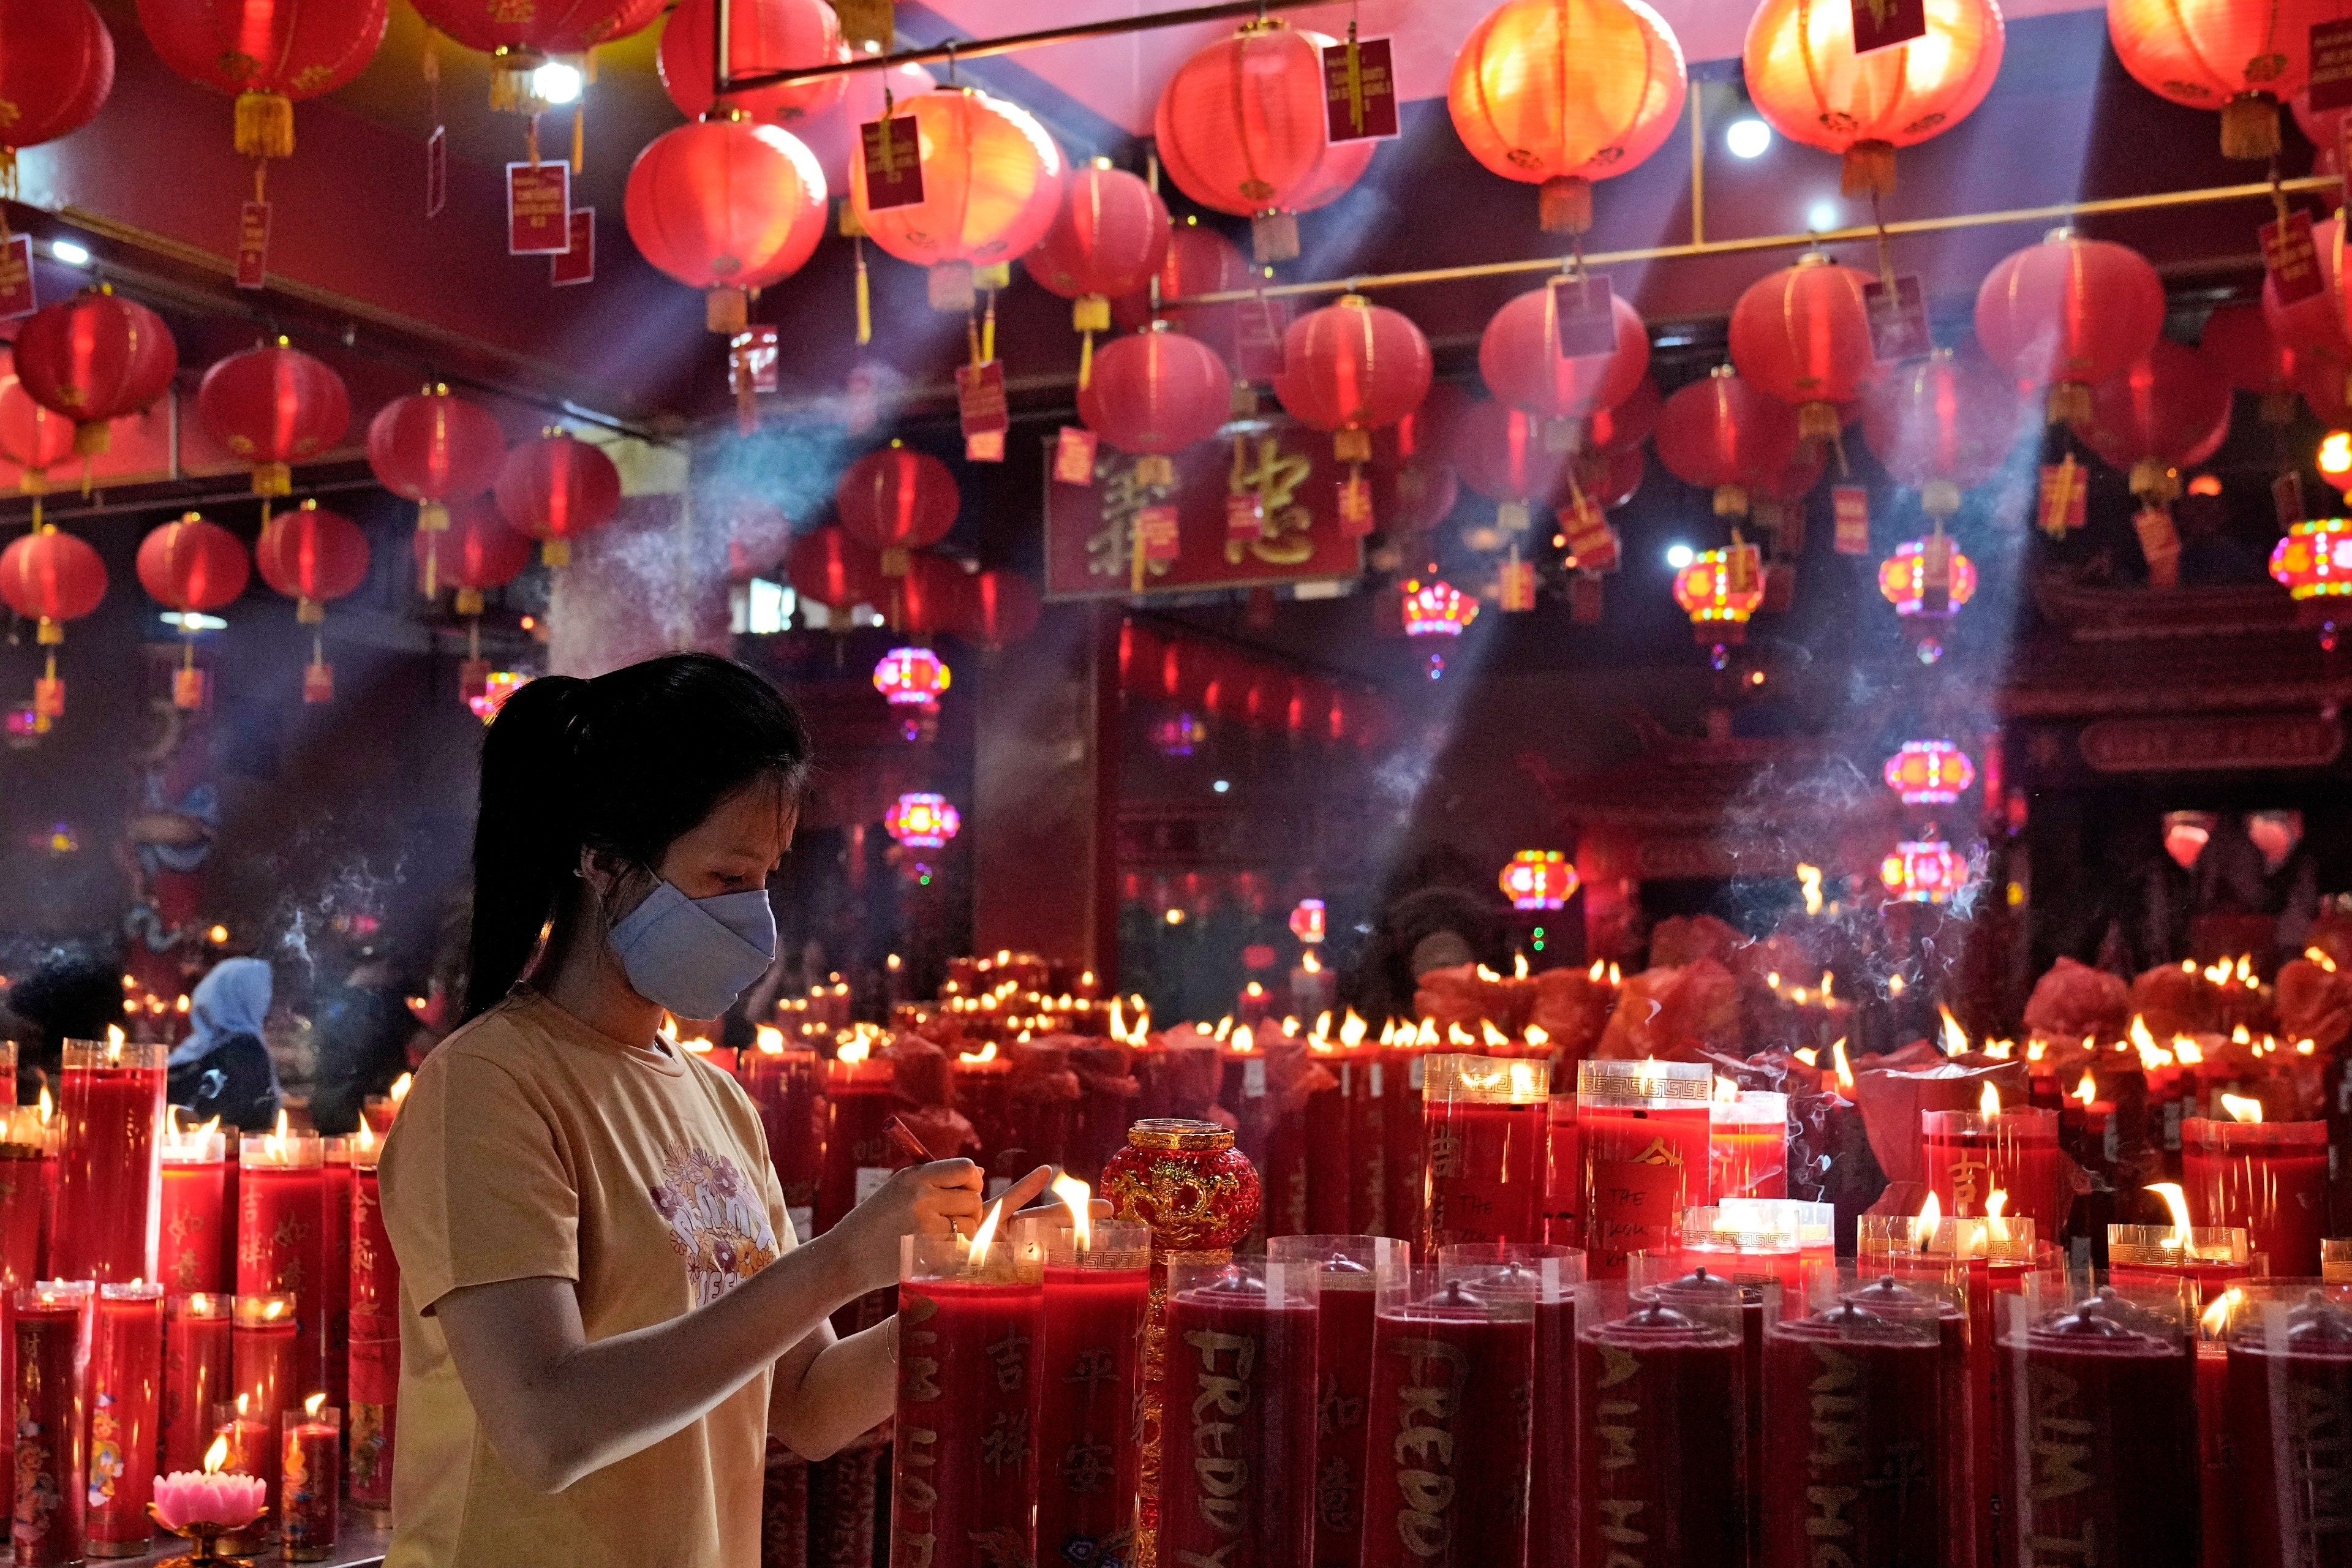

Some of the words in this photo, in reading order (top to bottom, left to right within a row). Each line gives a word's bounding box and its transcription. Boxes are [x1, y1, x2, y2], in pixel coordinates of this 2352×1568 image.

[1608, 1189, 1646, 1206] THE
[1947, 1149, 1986, 1203] 吉
[696, 1271, 746, 1307] SEE
[981, 1321, 1032, 1481] 吉祥
[1062, 1346, 1121, 1494] 平安
